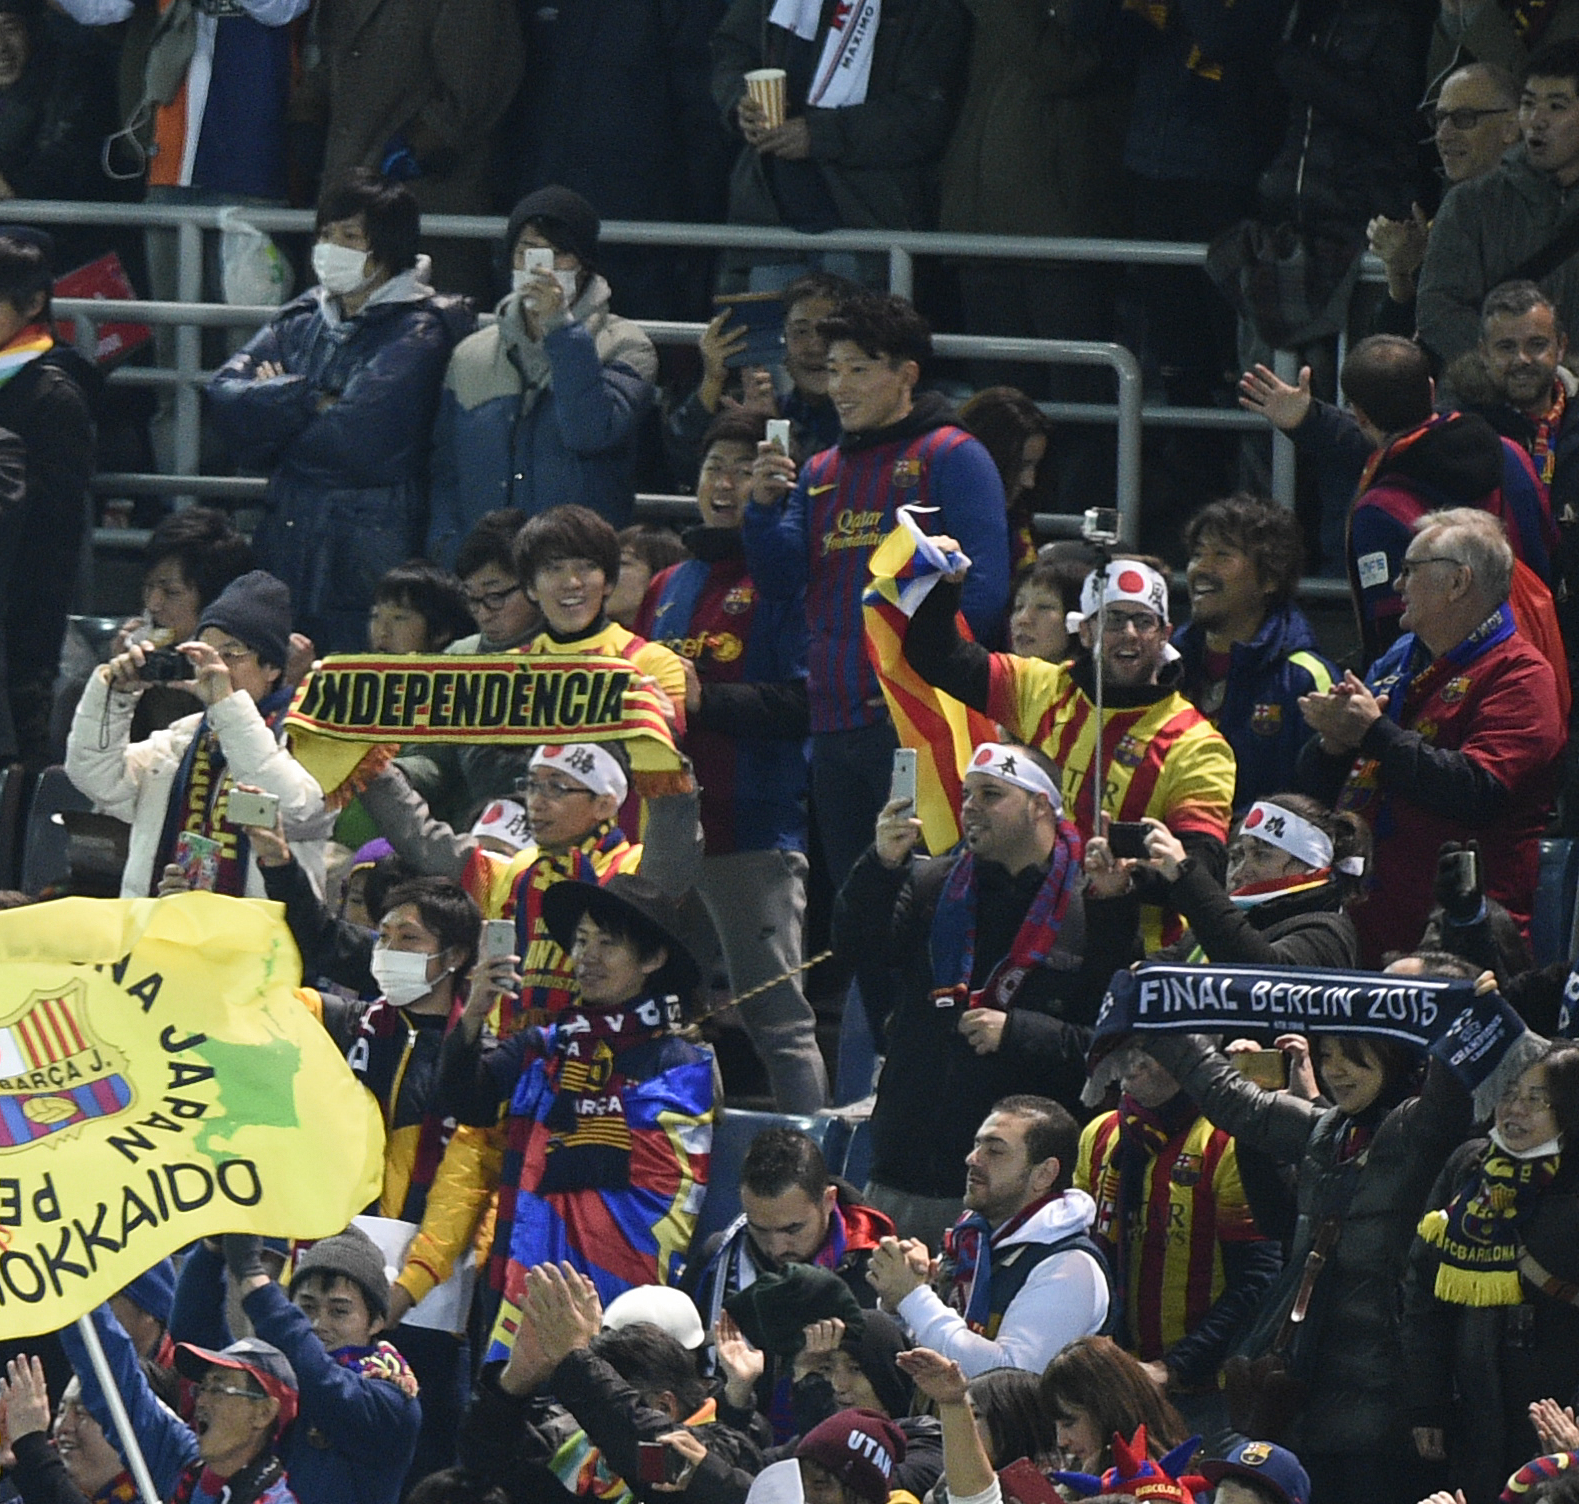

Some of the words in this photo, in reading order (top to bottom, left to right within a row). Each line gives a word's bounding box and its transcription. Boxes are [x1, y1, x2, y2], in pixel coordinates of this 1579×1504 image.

[820, 532, 893, 558] Foundatio
[837, 510, 883, 535] Qatar
[299, 667, 627, 730] INDEPENDÈNCIA
[1138, 975, 1239, 1014] FINAL
[1250, 979, 1363, 1018] BERLIN
[1367, 986, 1439, 1028] 2015
[106, 1024, 214, 1163] JAPAN
